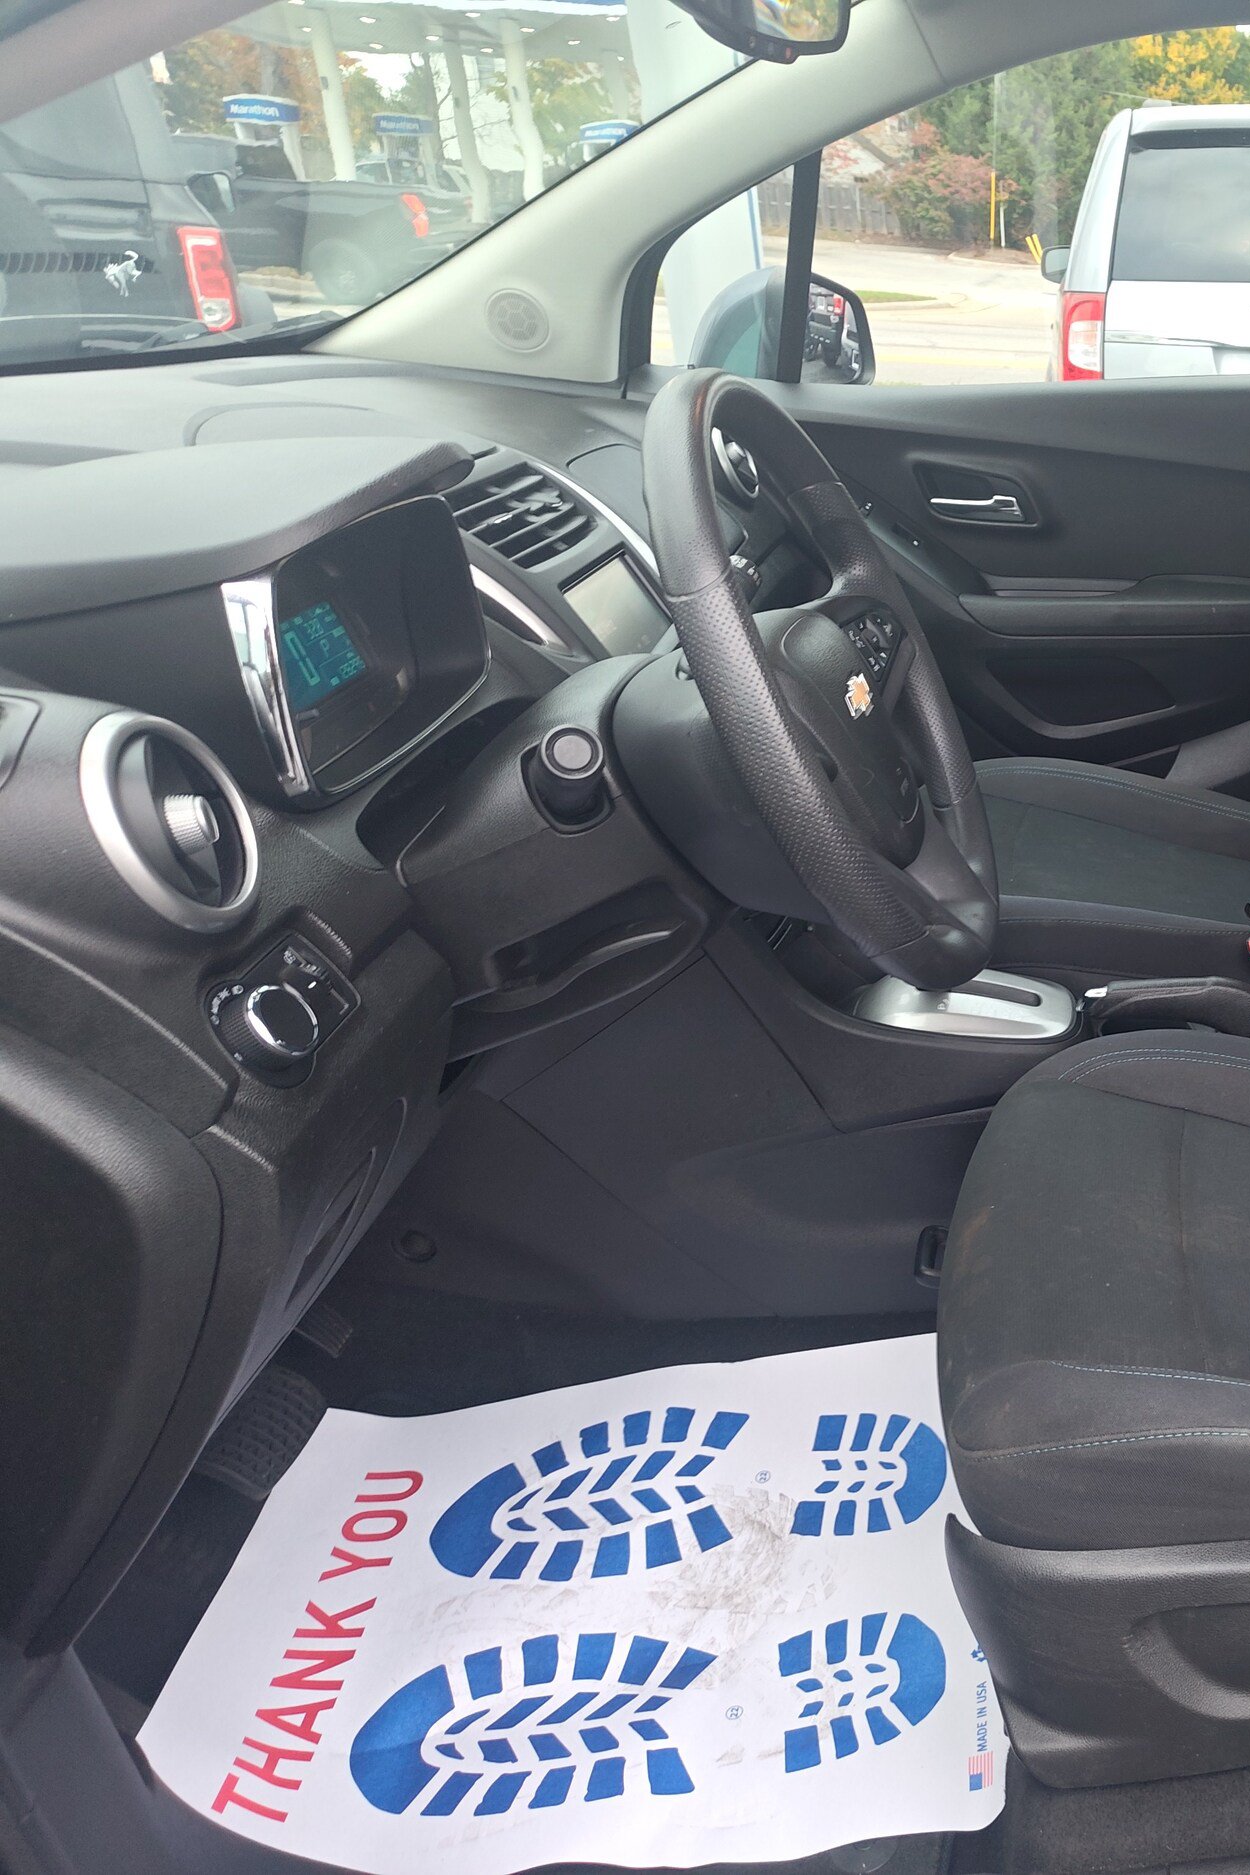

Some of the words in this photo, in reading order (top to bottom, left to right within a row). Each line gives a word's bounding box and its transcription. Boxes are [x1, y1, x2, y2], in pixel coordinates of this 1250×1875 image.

[230, 104, 279, 117] Marathon
[380, 120, 419, 130] Marathon
[211, 1597, 377, 1822] THANK
[318, 1471, 423, 1582] YOU
[977, 1681, 987, 1703] USA
[977, 1706, 987, 1719] IN
[977, 1721, 987, 1752] MADE
